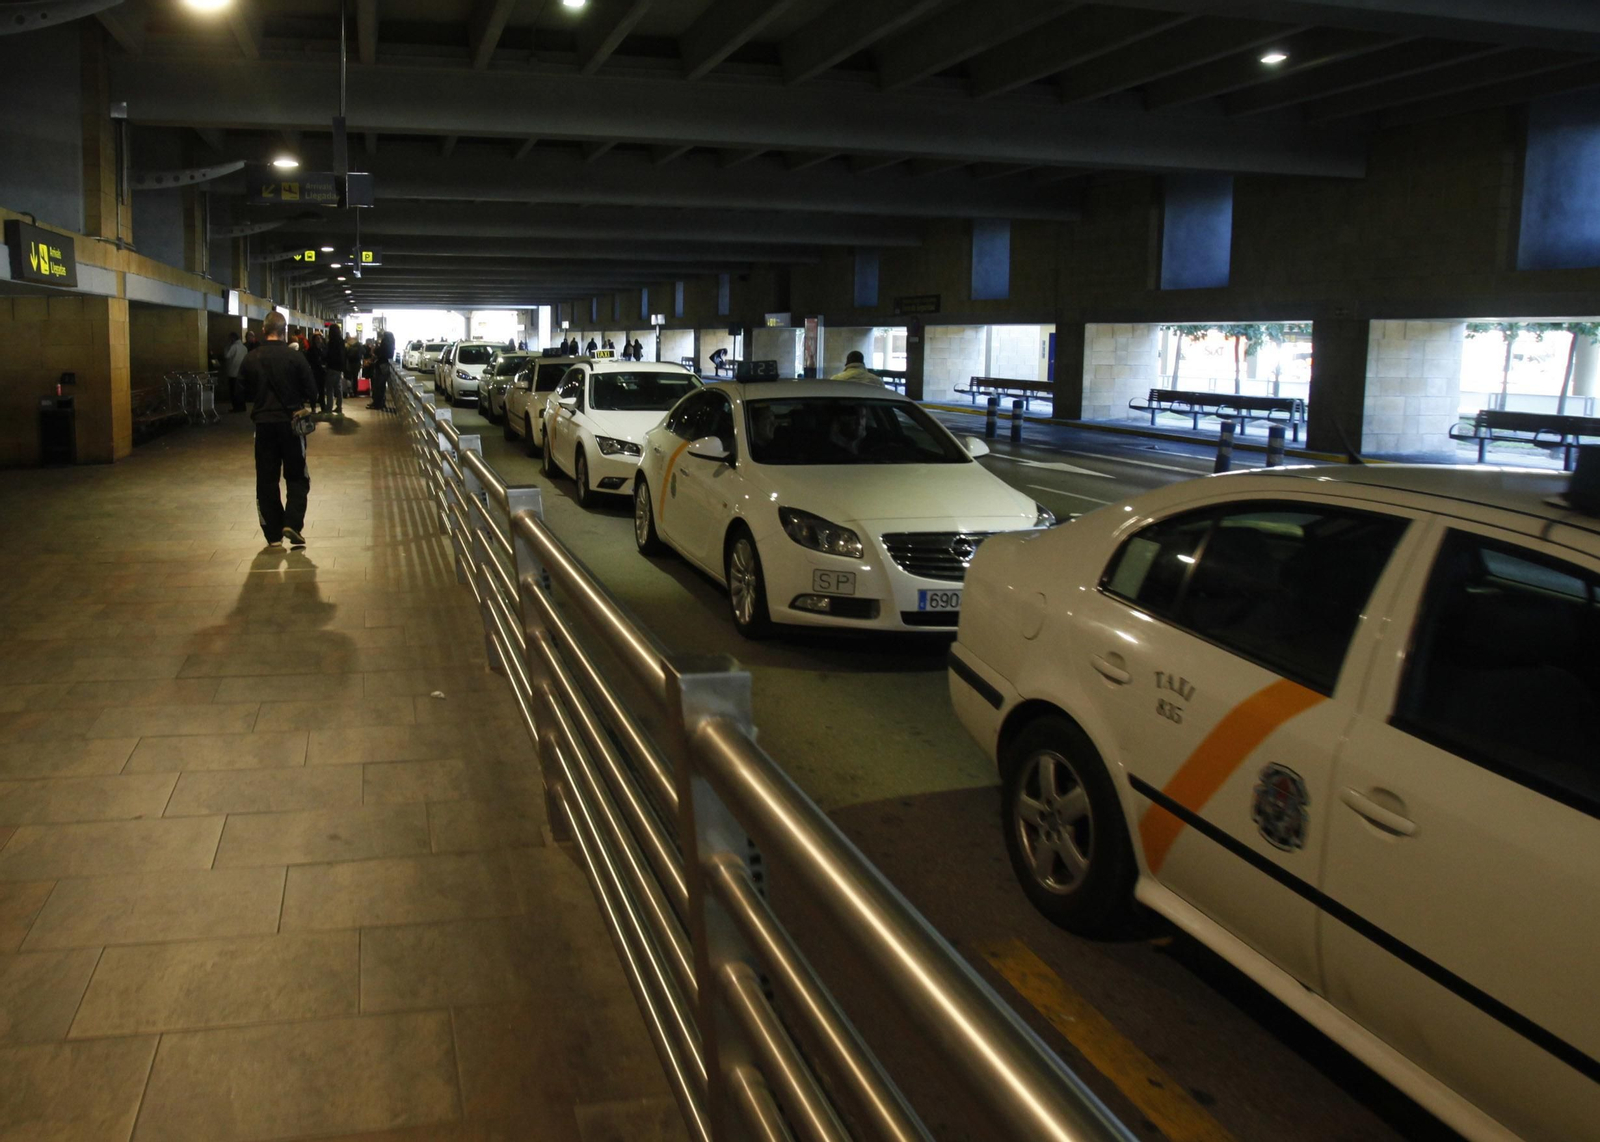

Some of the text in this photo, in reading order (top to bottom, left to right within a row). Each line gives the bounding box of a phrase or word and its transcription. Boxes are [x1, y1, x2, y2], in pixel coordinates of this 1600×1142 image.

[818, 573, 850, 591] SP
[929, 592, 962, 609] 690
[1154, 671, 1196, 702] TAXI
